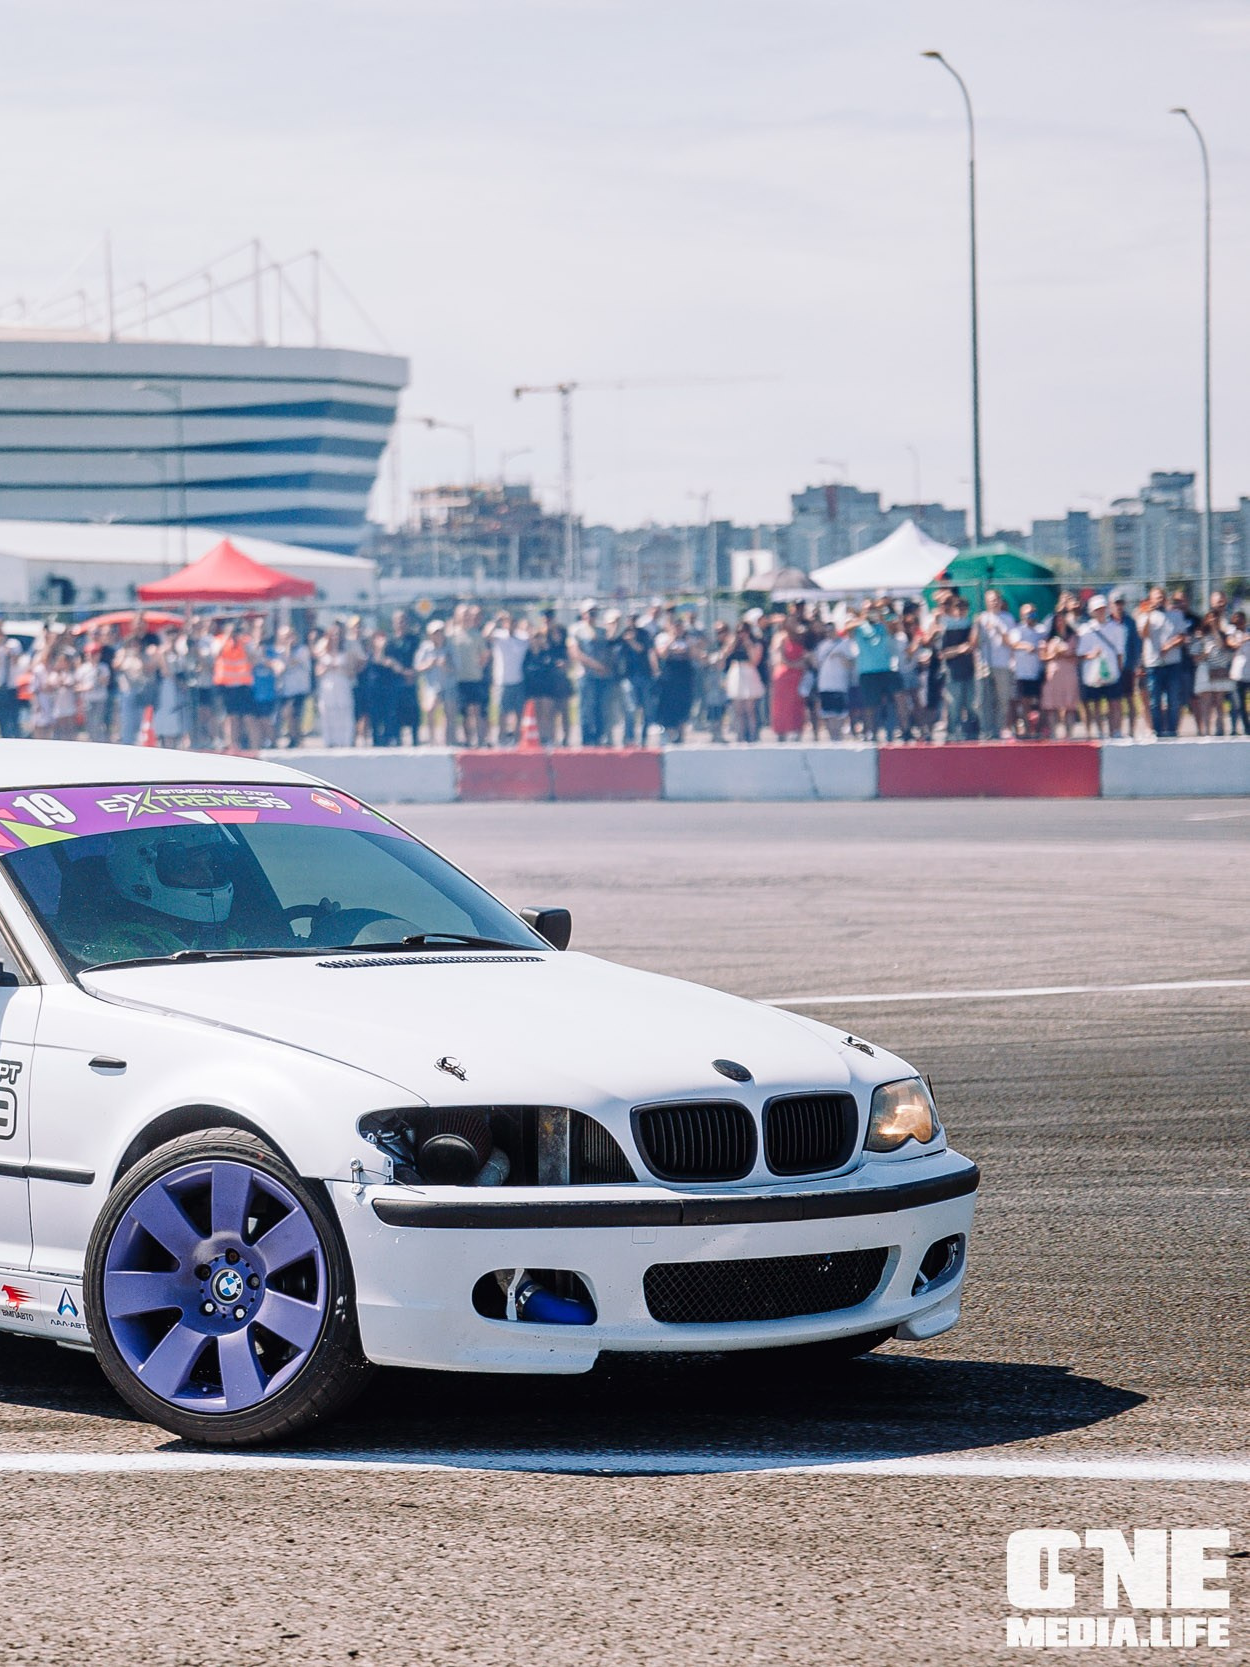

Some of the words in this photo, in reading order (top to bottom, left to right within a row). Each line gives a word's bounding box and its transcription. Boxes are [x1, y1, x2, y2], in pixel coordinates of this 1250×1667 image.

[12, 792, 77, 827] 19
[96, 787, 292, 823] EXTREME39
[1, 1309, 34, 1322] ВМПАВТО
[50, 1319, 87, 1330] ЛАЛ-АВТ
